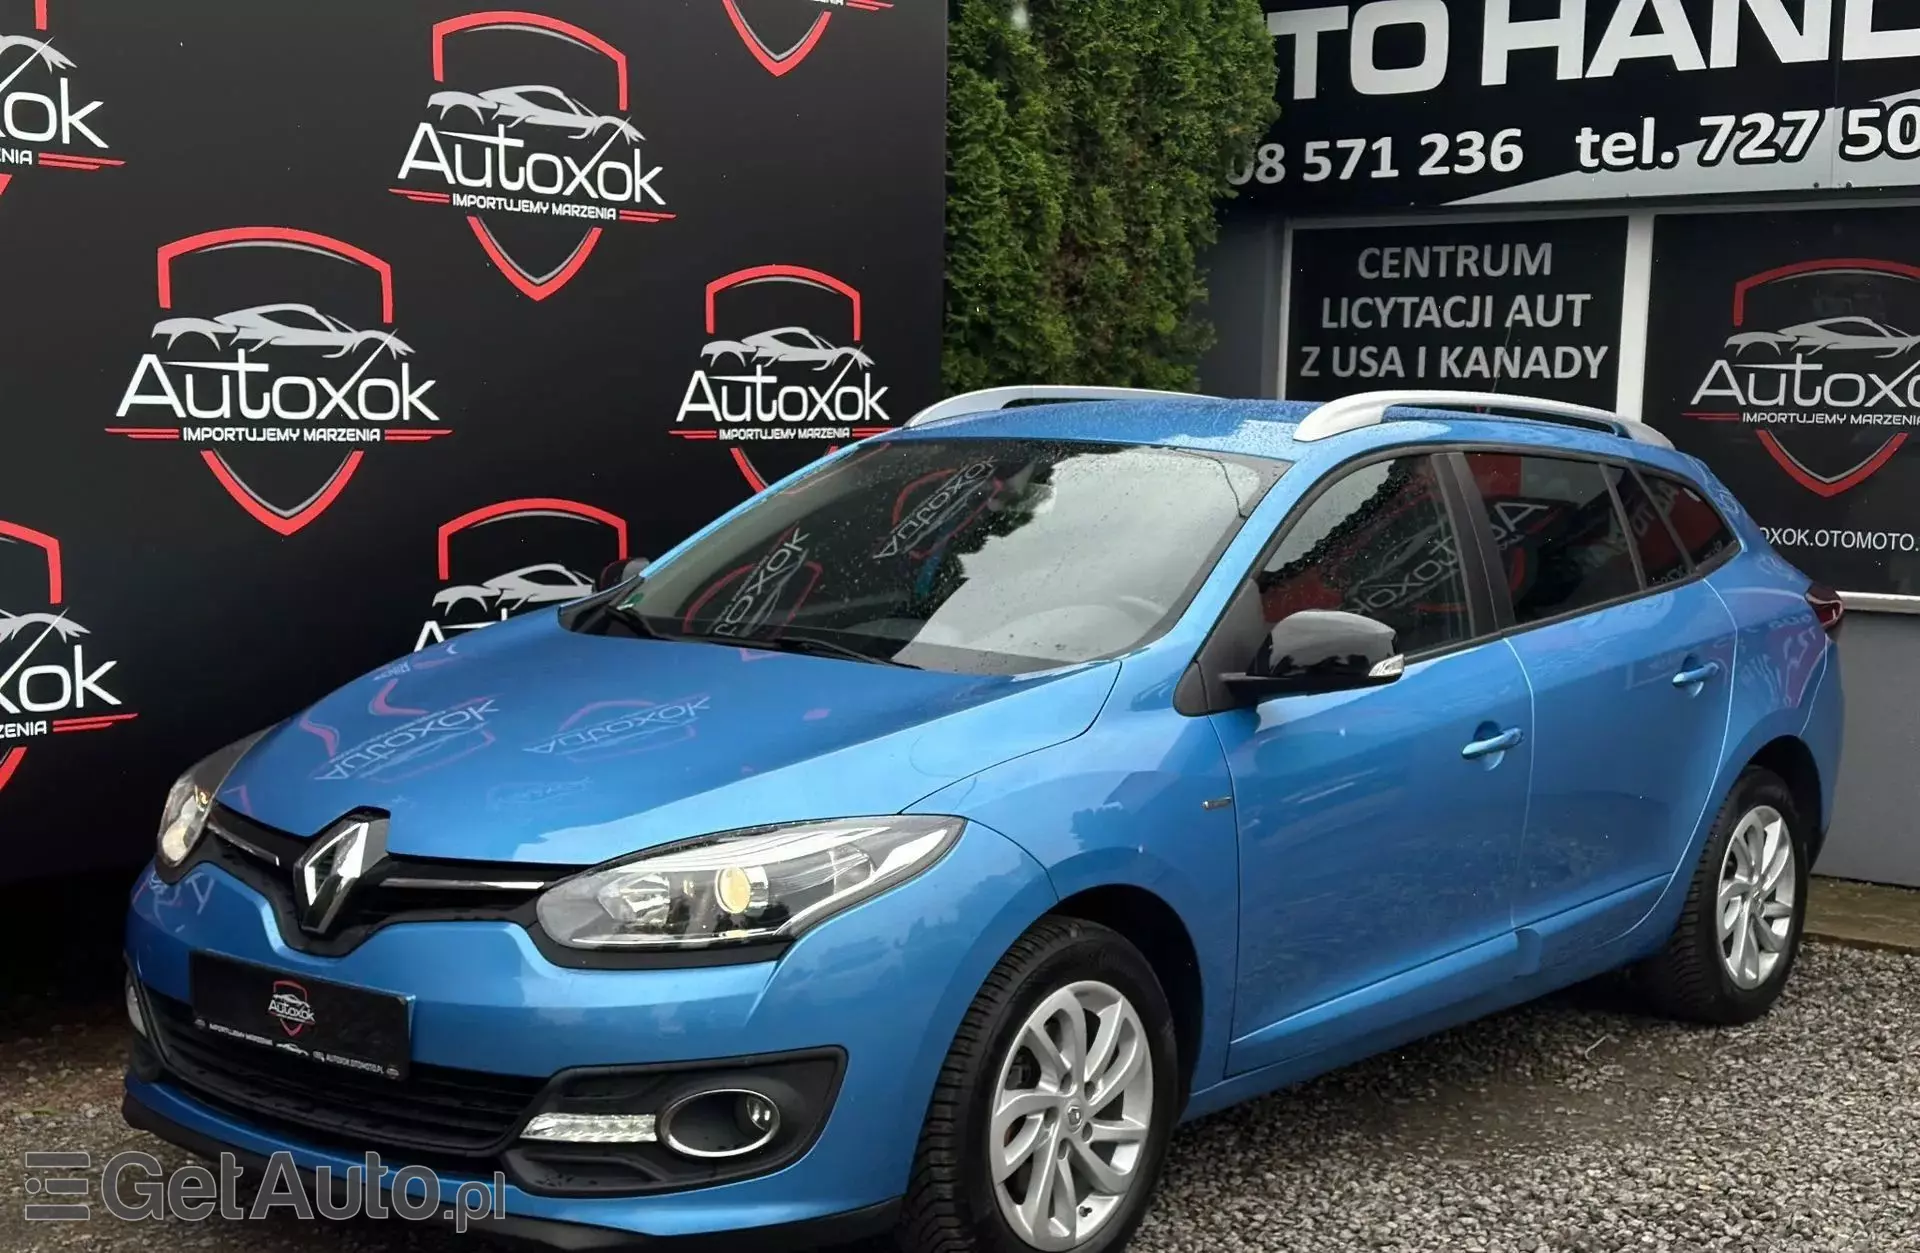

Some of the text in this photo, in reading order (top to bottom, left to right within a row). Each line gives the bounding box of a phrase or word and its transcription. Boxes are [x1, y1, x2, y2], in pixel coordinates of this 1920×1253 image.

[397, 116, 667, 206] Autoxok
[1302, 137, 1399, 182] 571
[1418, 128, 1524, 176] 236
[1576, 117, 1674, 168] tel.
[1699, 112, 1820, 162] 727
[453, 193, 616, 220] IMPORTUJEMY MARZENIA
[1358, 243, 1552, 279] CENTRUM
[1321, 294, 1591, 328] LICYTACJI AUT
[115, 328, 440, 421] Autoxok
[1300, 346, 1609, 379] Z USA I KANADY
[676, 352, 890, 422] Autoxok
[1690, 353, 1920, 408] Autox
[183, 427, 381, 442] IMPORTUJEMY MARZENIA
[719, 427, 850, 440] IMPORTUJEMY MARZENIA
[1743, 412, 1846, 425] IMPORTUJEMY
[268, 999, 316, 1022] Autoxok
